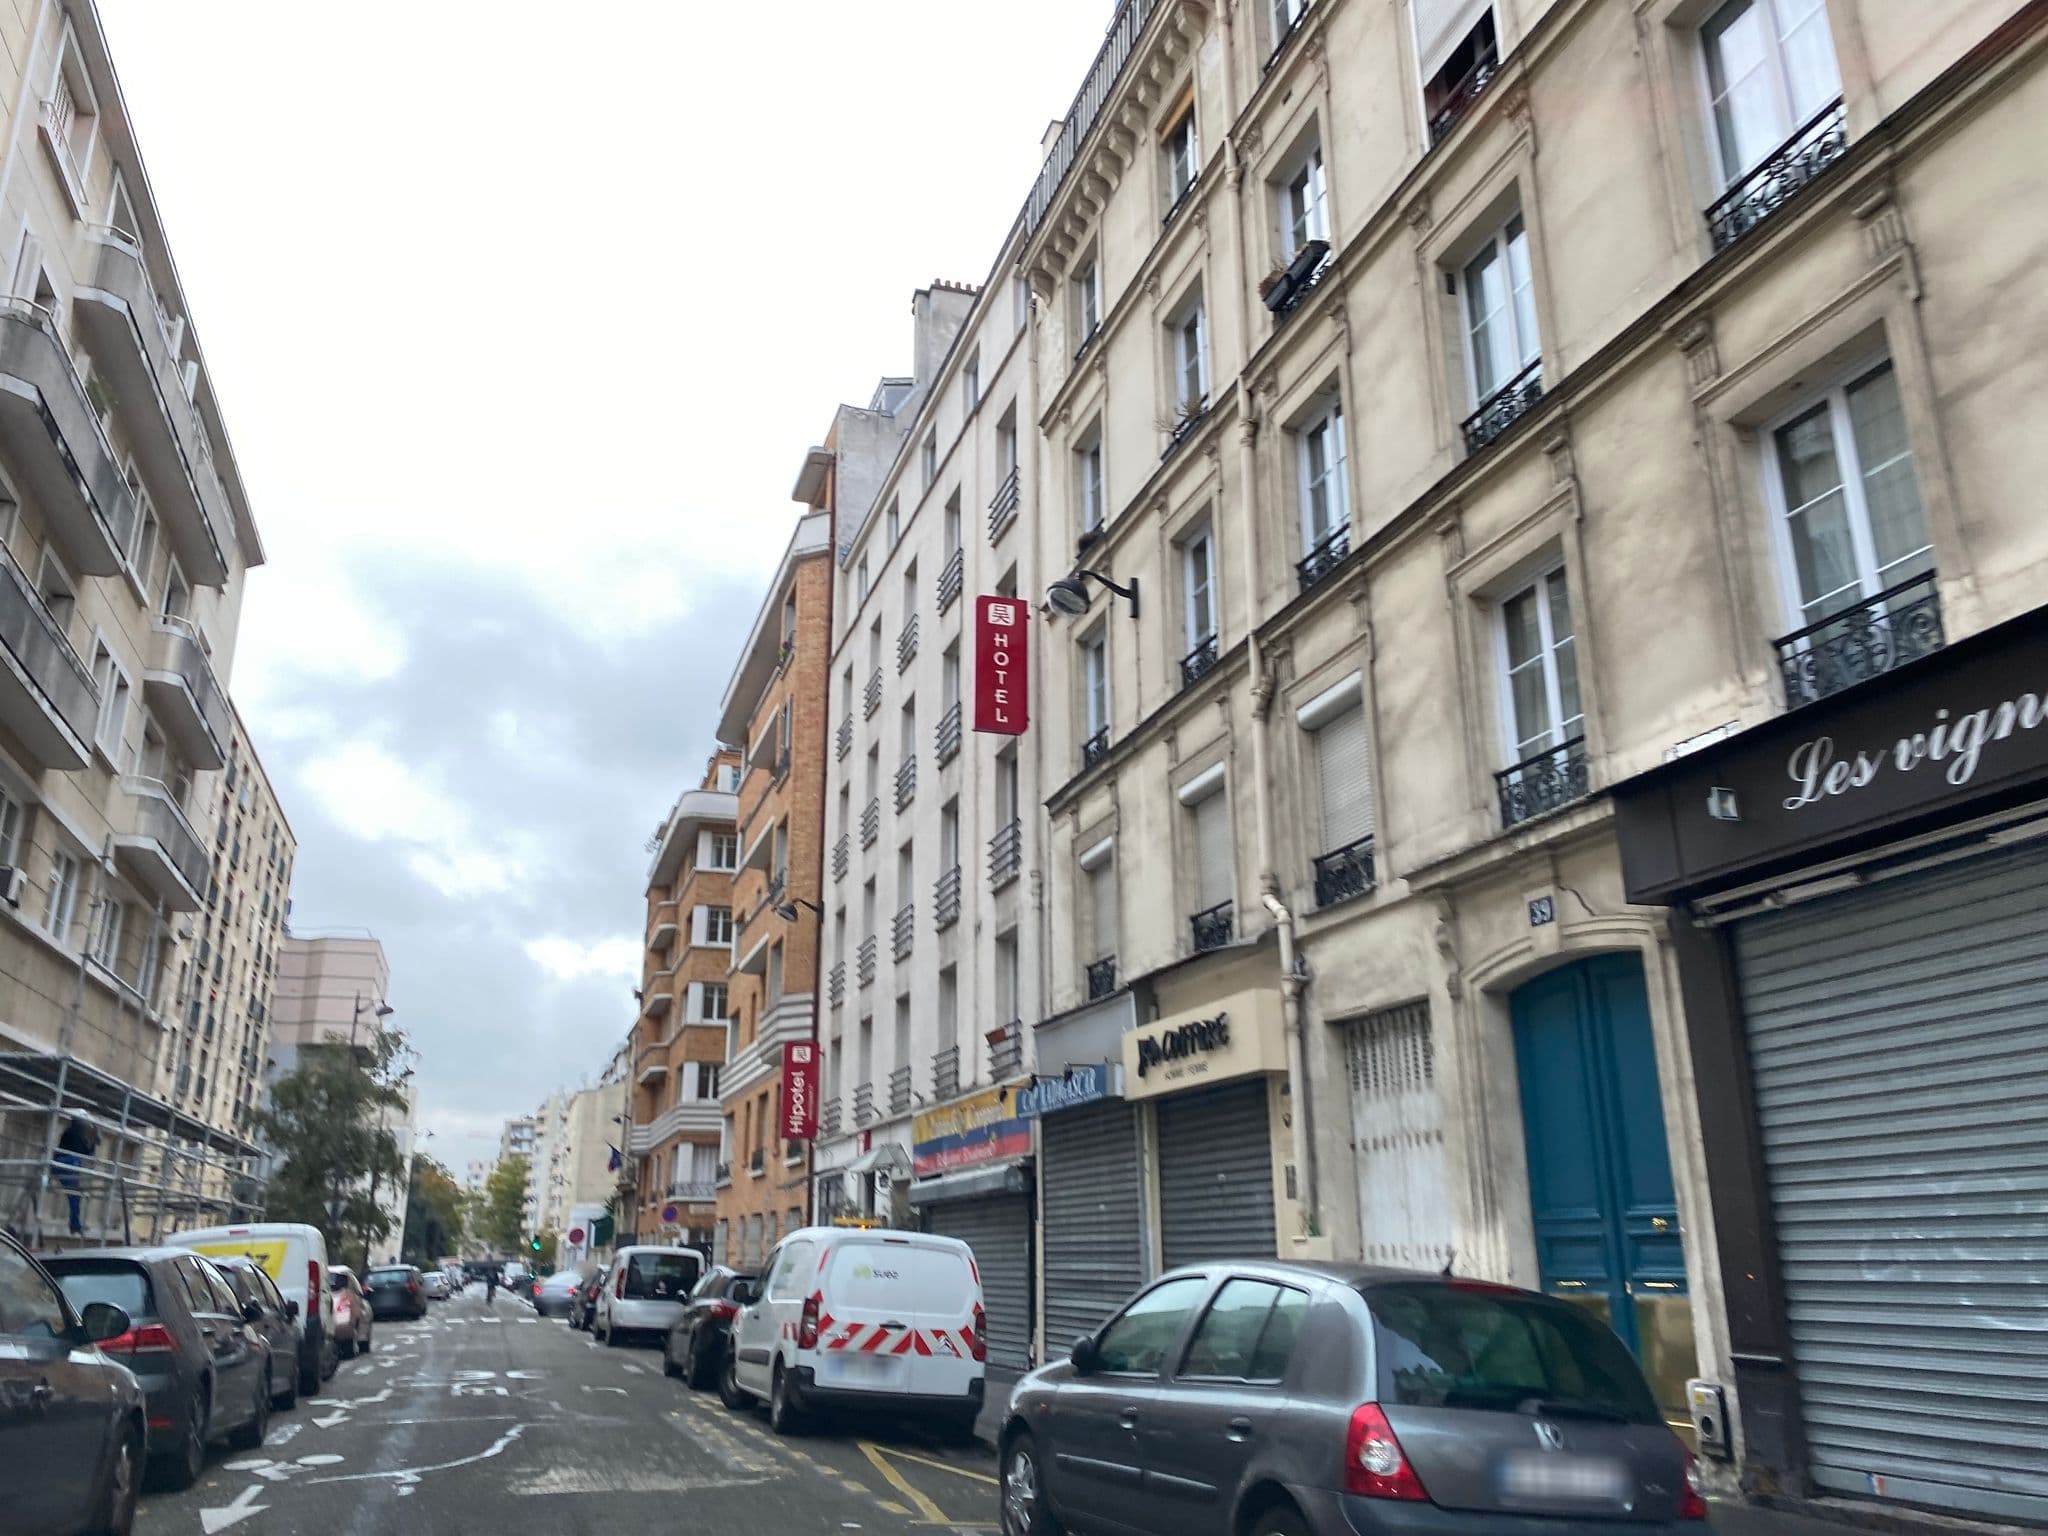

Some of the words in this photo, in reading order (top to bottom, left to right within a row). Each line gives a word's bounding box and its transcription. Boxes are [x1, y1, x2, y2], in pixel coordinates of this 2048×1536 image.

[993, 632, 1010, 723] HOTEL
[1782, 736, 1888, 810] Les
[1893, 692, 2048, 785] vign
[789, 1070, 807, 1134] Hipotel
